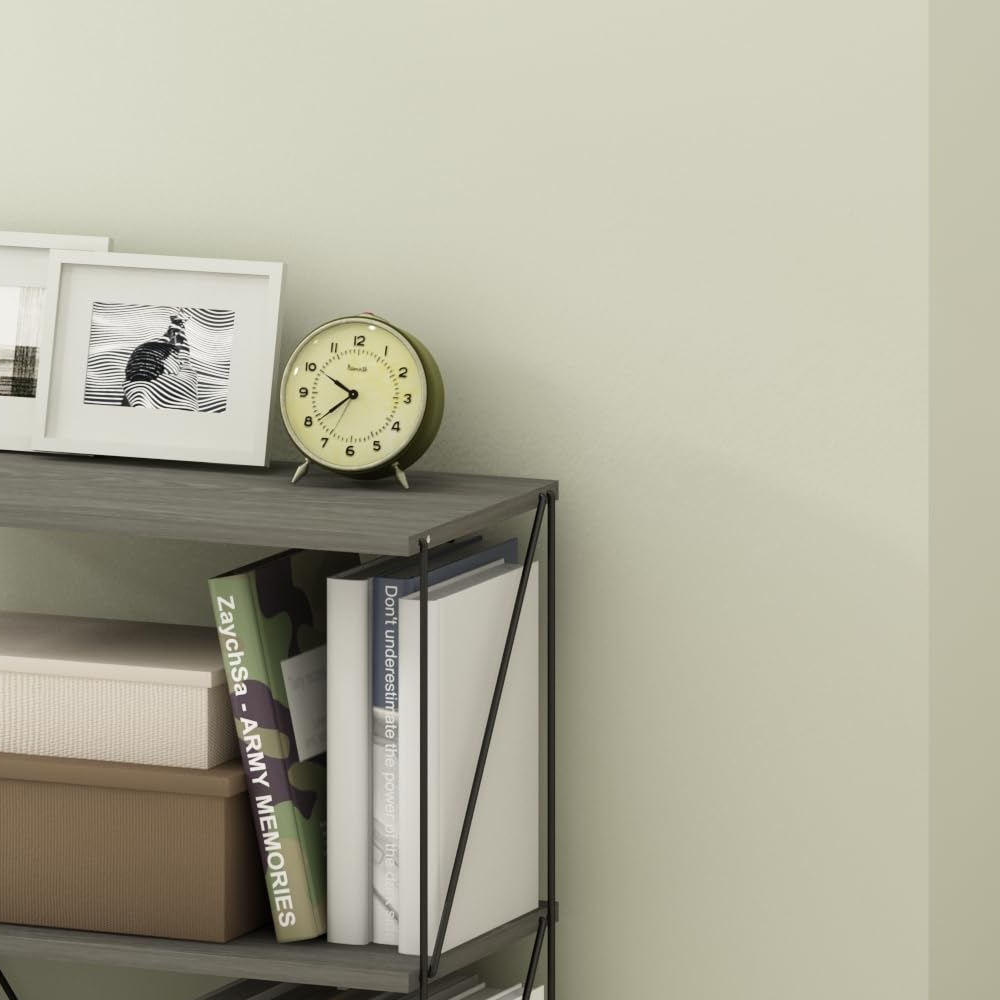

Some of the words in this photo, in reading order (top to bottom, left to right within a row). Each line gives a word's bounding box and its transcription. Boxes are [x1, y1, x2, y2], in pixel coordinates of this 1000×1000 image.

[354, 336, 366, 346] 12
[330, 342, 338, 353] 11
[305, 362, 317, 372] 10
[398, 367, 408, 378] 2
[298, 386, 308, 398] 9
[403, 394, 412, 404] 3
[304, 416, 313, 427] 8
[391, 422, 400, 432] 4
[320, 438, 329, 448] 7
[372, 440, 382, 451] 5
[345, 446, 355, 456] 6
[384, 584, 398, 626] Don't
[384, 629, 398, 738] underestimate
[384, 744, 398, 768] the
[215, 595, 249, 697] ZaychSa
[239, 715, 270, 788] ARMY
[256, 794, 296, 929] MEMORIES
[381, 772, 398, 818] power
